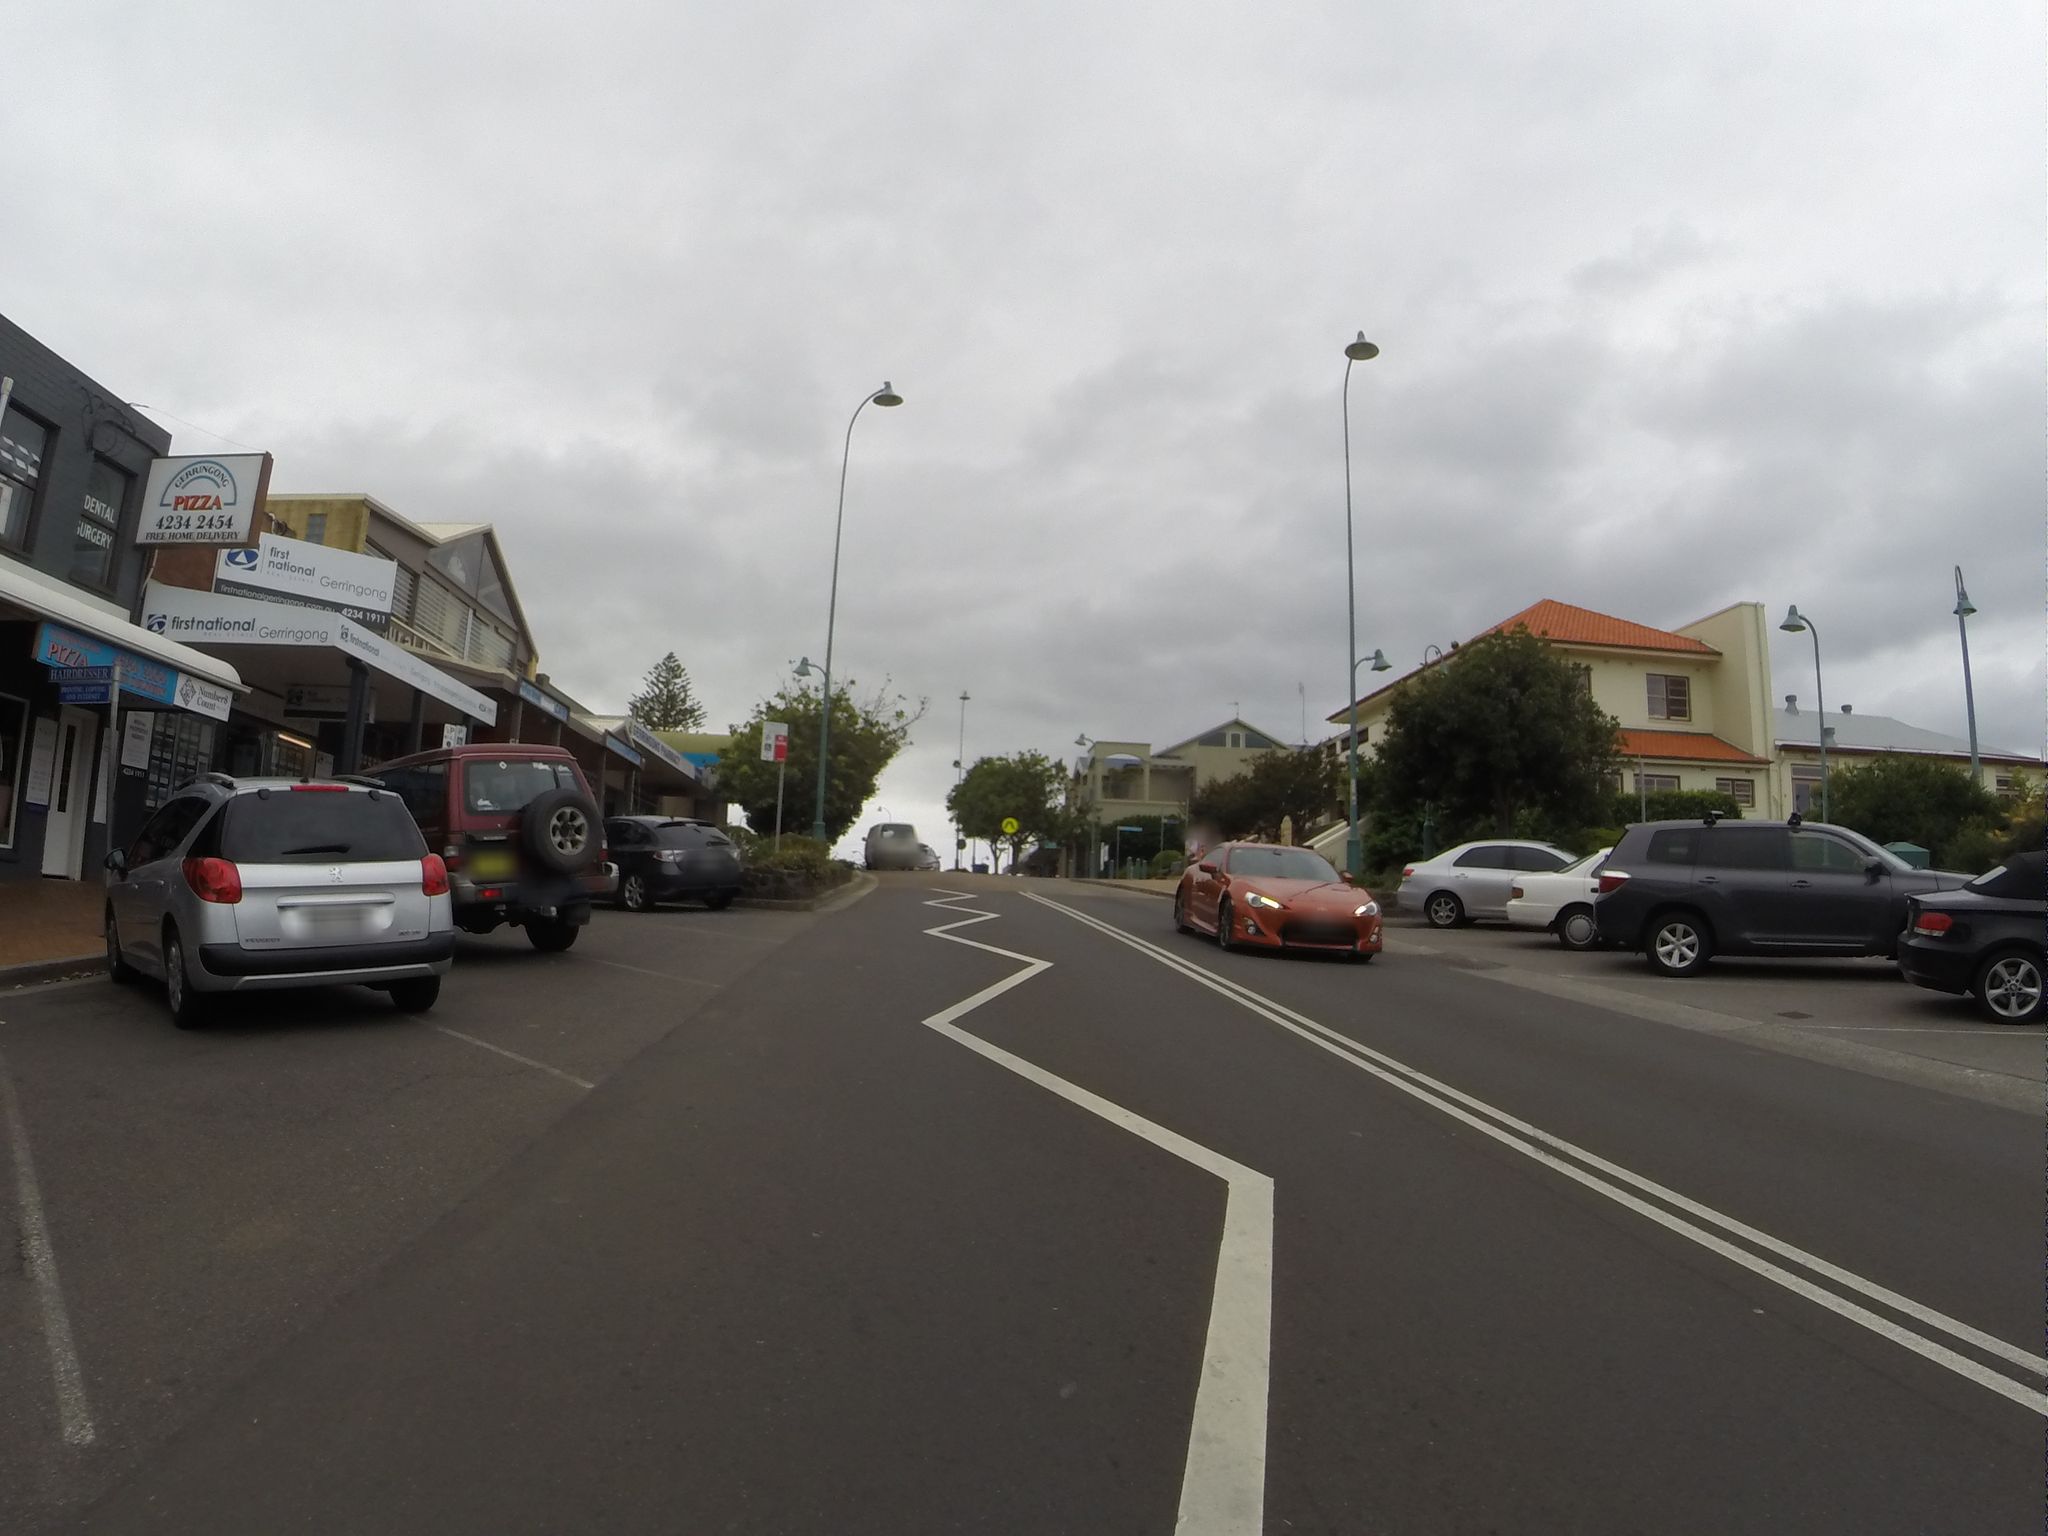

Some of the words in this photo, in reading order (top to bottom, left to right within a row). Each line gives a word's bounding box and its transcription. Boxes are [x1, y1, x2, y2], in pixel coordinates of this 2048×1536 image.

[175, 465, 230, 488] GERRINGONG
[84, 494, 115, 524] DENTAL
[172, 495, 222, 511] PIZZA
[156, 515, 191, 529] 4234
[197, 515, 234, 529] 2454
[145, 531, 166, 540] FREE
[168, 531, 194, 540] HOME
[196, 531, 240, 540] DELIVERY
[270, 547, 290, 560] first
[268, 559, 316, 577] national
[320, 576, 388, 601] Gerringong
[341, 607, 364, 620] 4234
[366, 612, 386, 624] 1911
[258, 626, 329, 642] Gerringong
[50, 668, 109, 680] HAIRDRESSER
[197, 697, 216, 711] Count
